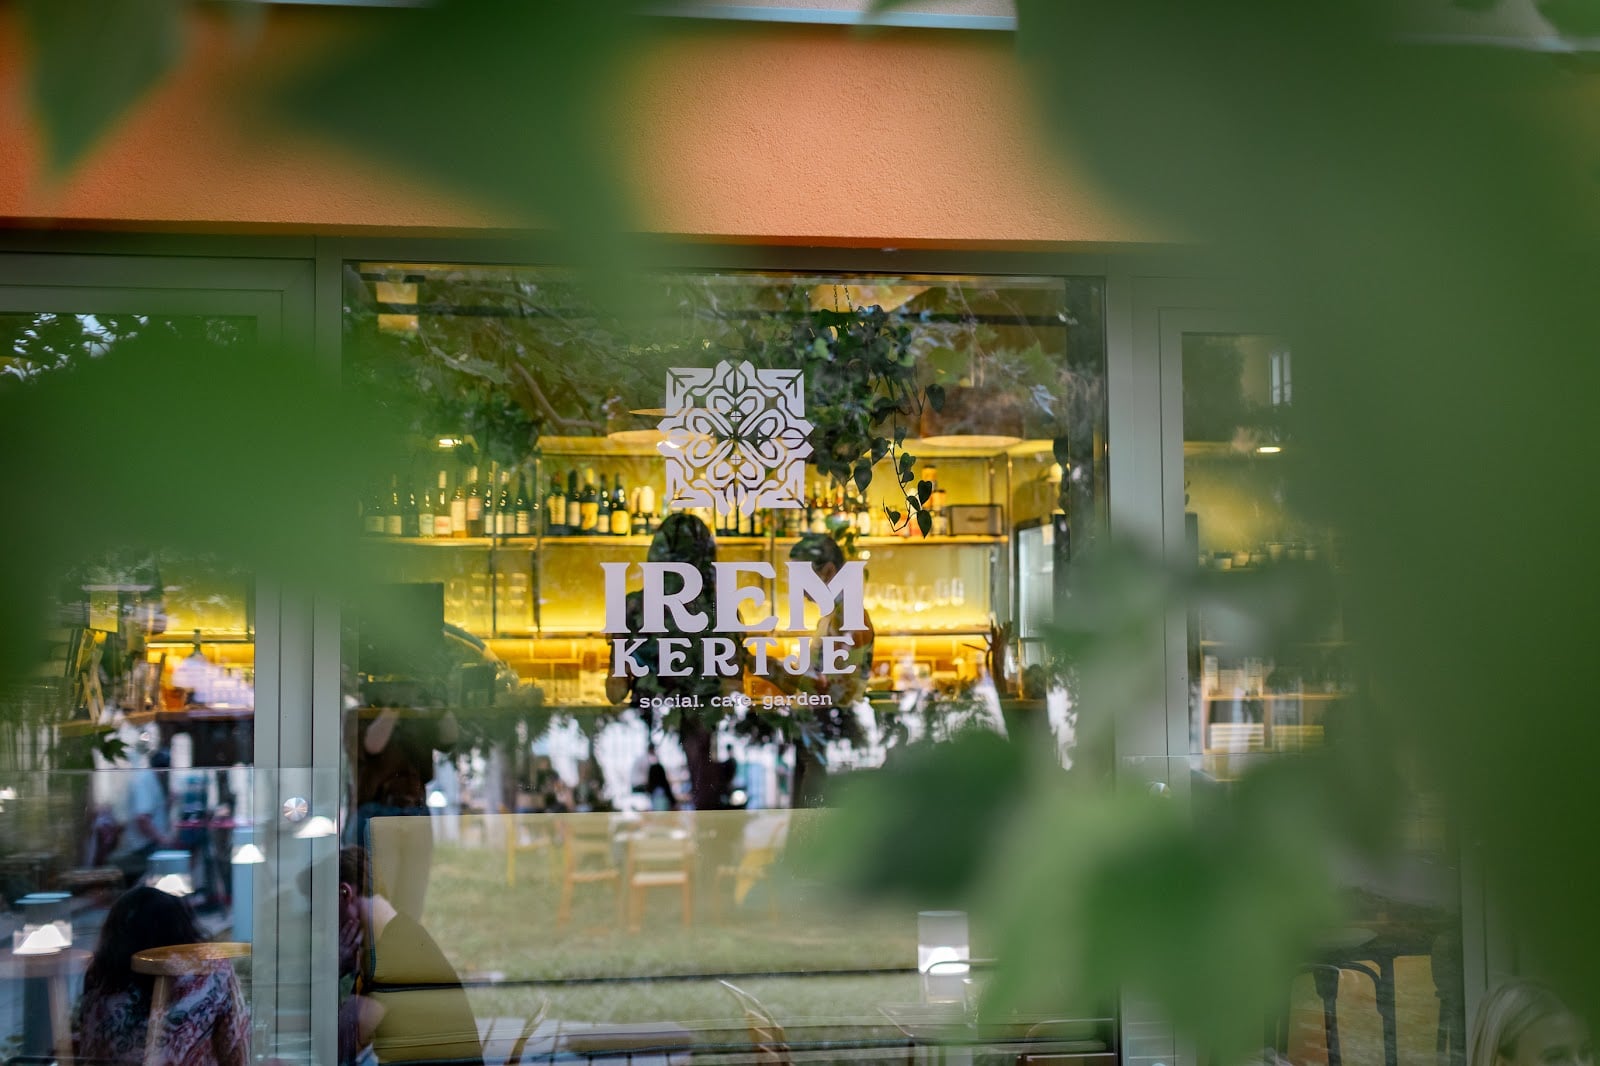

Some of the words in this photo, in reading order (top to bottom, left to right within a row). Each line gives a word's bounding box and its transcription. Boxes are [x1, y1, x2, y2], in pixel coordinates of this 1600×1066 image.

[600, 561, 869, 633] IREM
[612, 636, 856, 678] KERTJE
[639, 694, 704, 708] social.
[762, 692, 832, 709] garden
